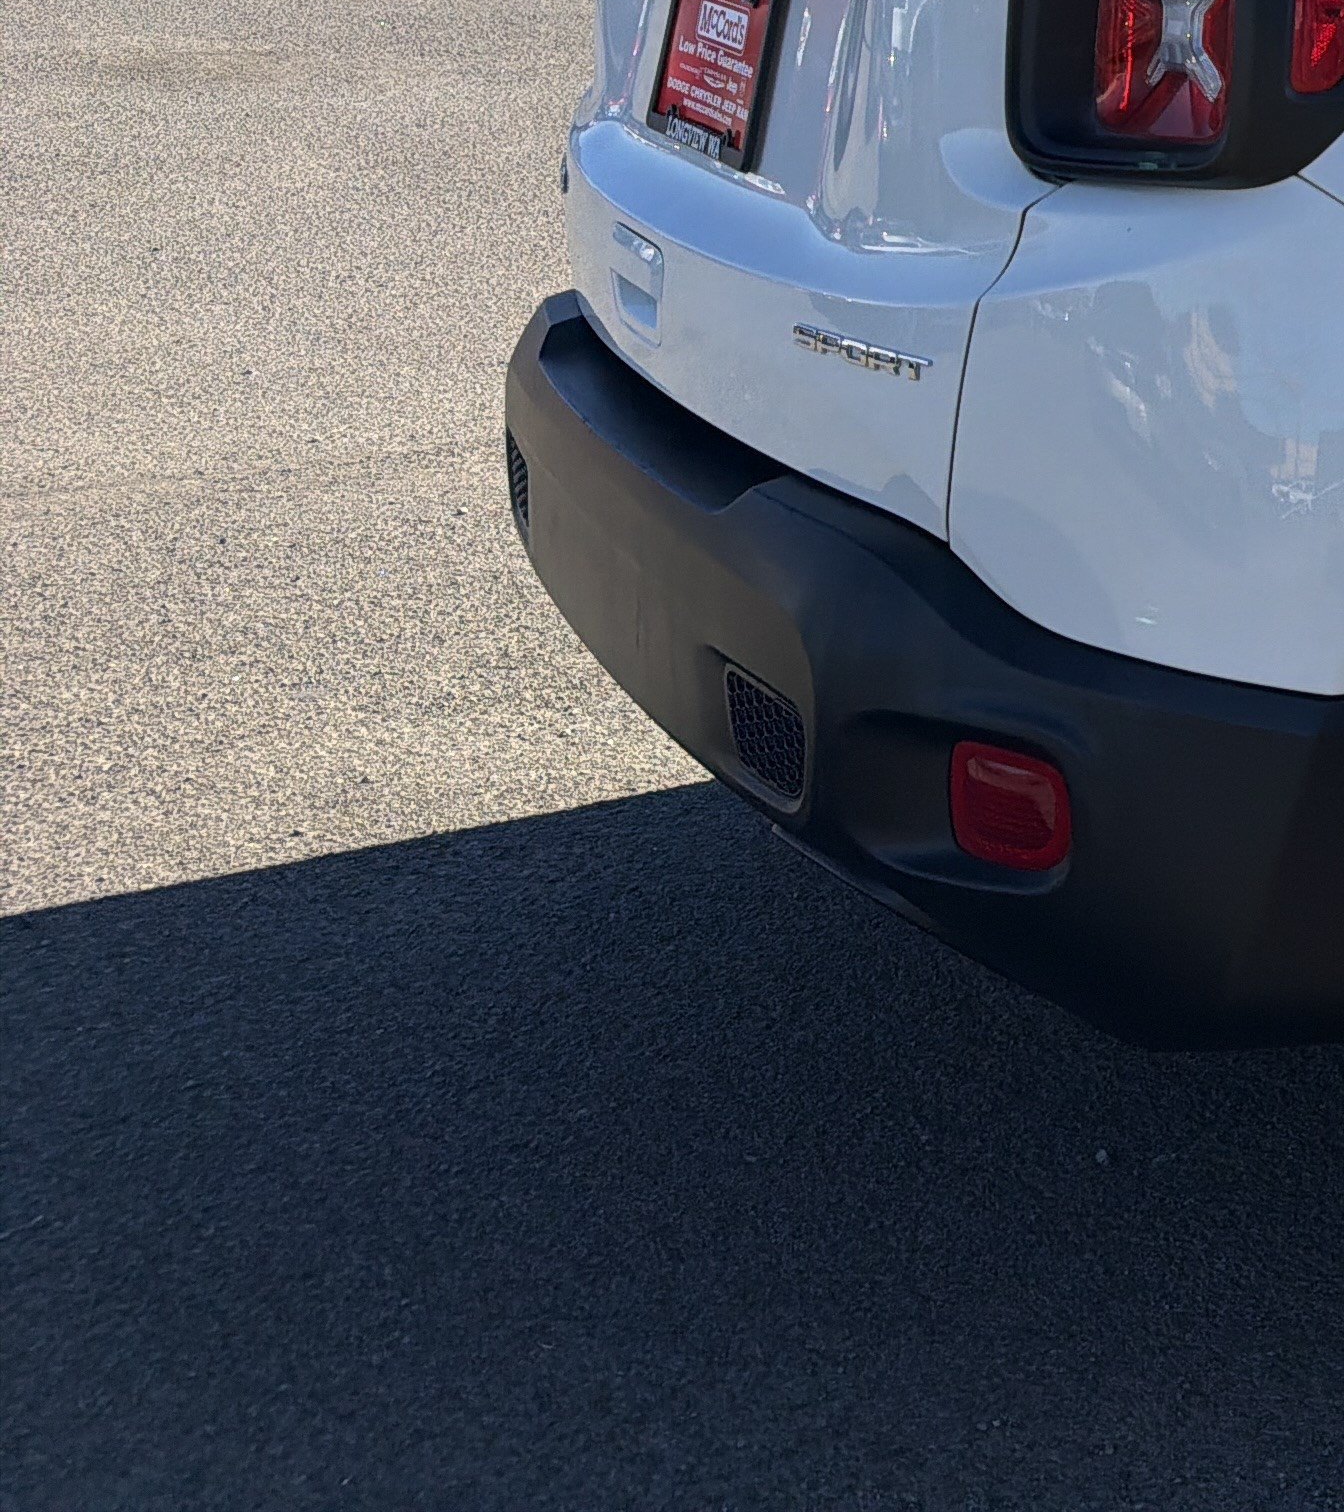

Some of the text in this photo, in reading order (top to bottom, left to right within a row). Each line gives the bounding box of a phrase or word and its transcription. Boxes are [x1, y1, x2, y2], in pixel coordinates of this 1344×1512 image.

[700, 4, 745, 44] McCord's
[679, 36, 696, 54] Low
[695, 41, 717, 63] Price
[717, 55, 754, 79] Guarantee
[667, 76, 690, 94] DODGE
[690, 85, 722, 108] CHRYSLER
[721, 98, 737, 115] JEEP
[666, 116, 720, 159] LONGVIEW WA
[792, 322, 934, 381] SPORT
